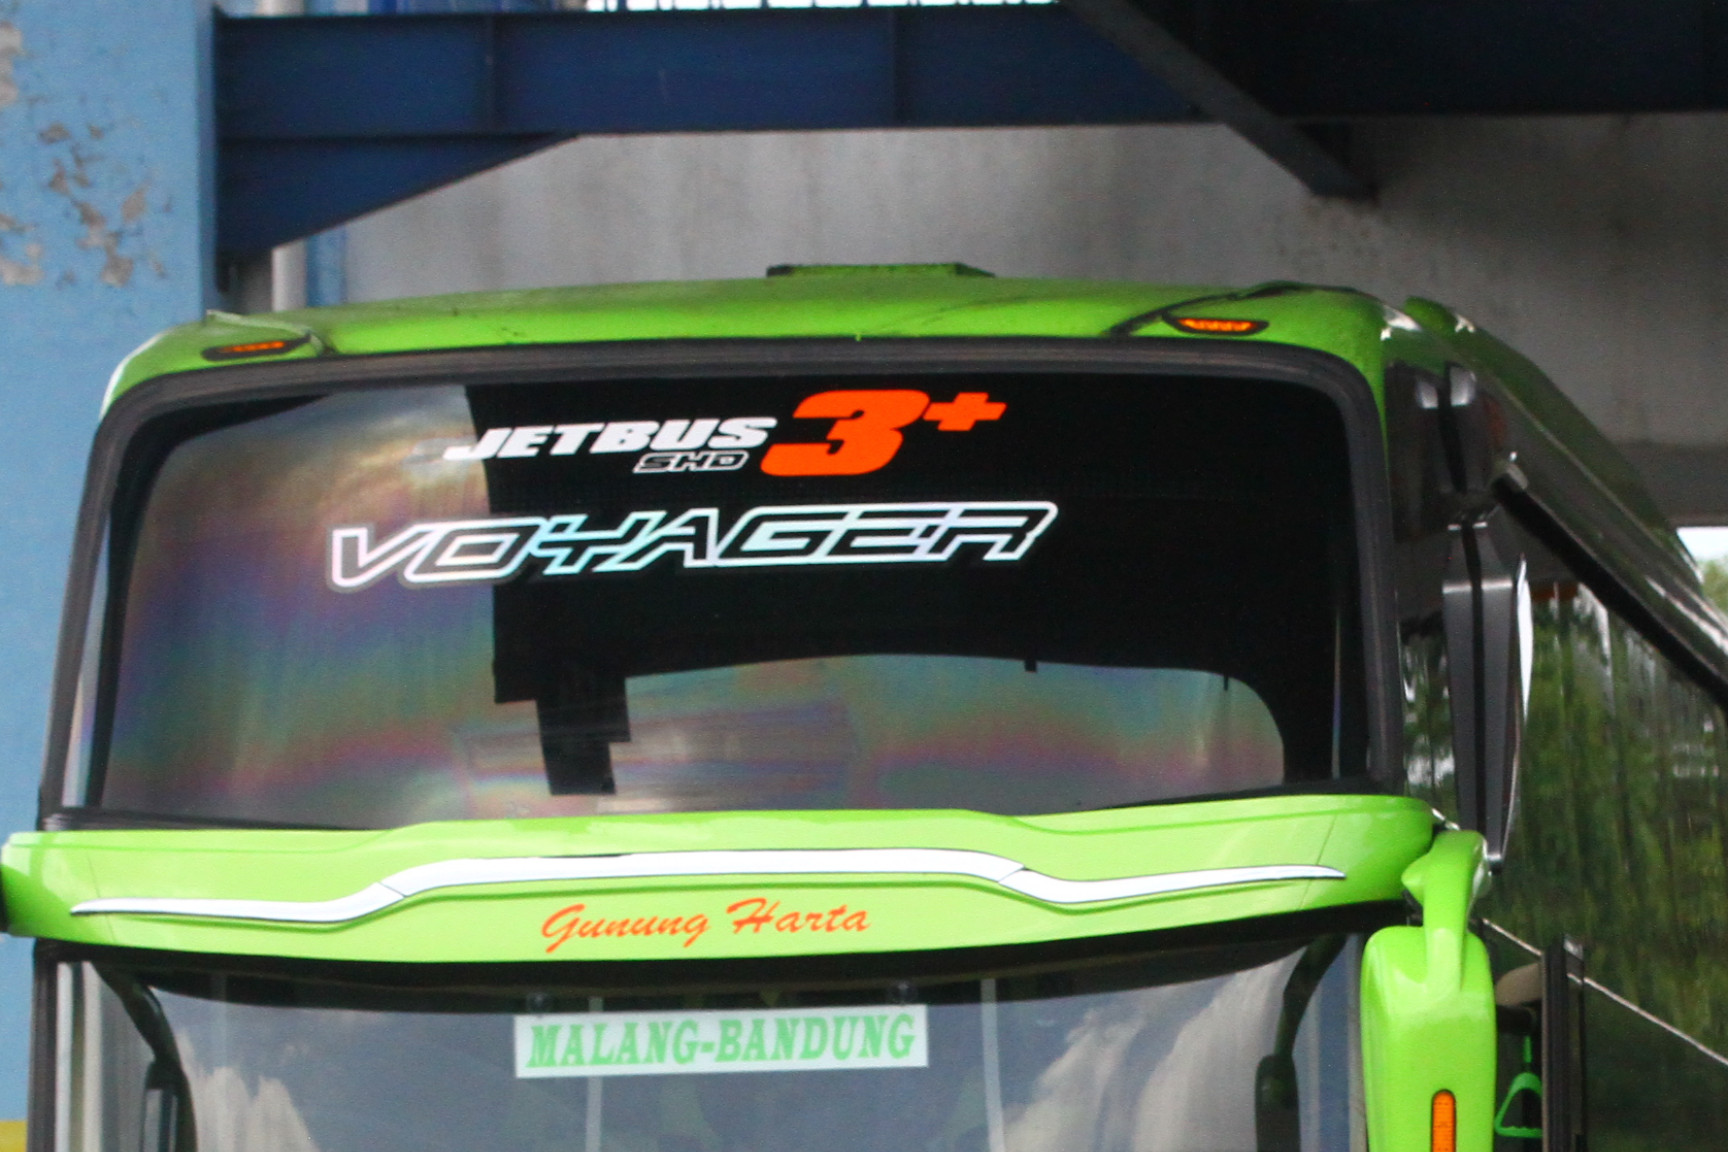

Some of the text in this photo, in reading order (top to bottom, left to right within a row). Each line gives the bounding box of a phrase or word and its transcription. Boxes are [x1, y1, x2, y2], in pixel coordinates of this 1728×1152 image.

[442, 415, 778, 462] JETBUS
[632, 450, 750, 475] SHD
[330, 501, 1060, 588] VOYAGER
[541, 897, 871, 953] Gunung Harta
[525, 1014, 917, 1068] MALANG-BANDUNG
